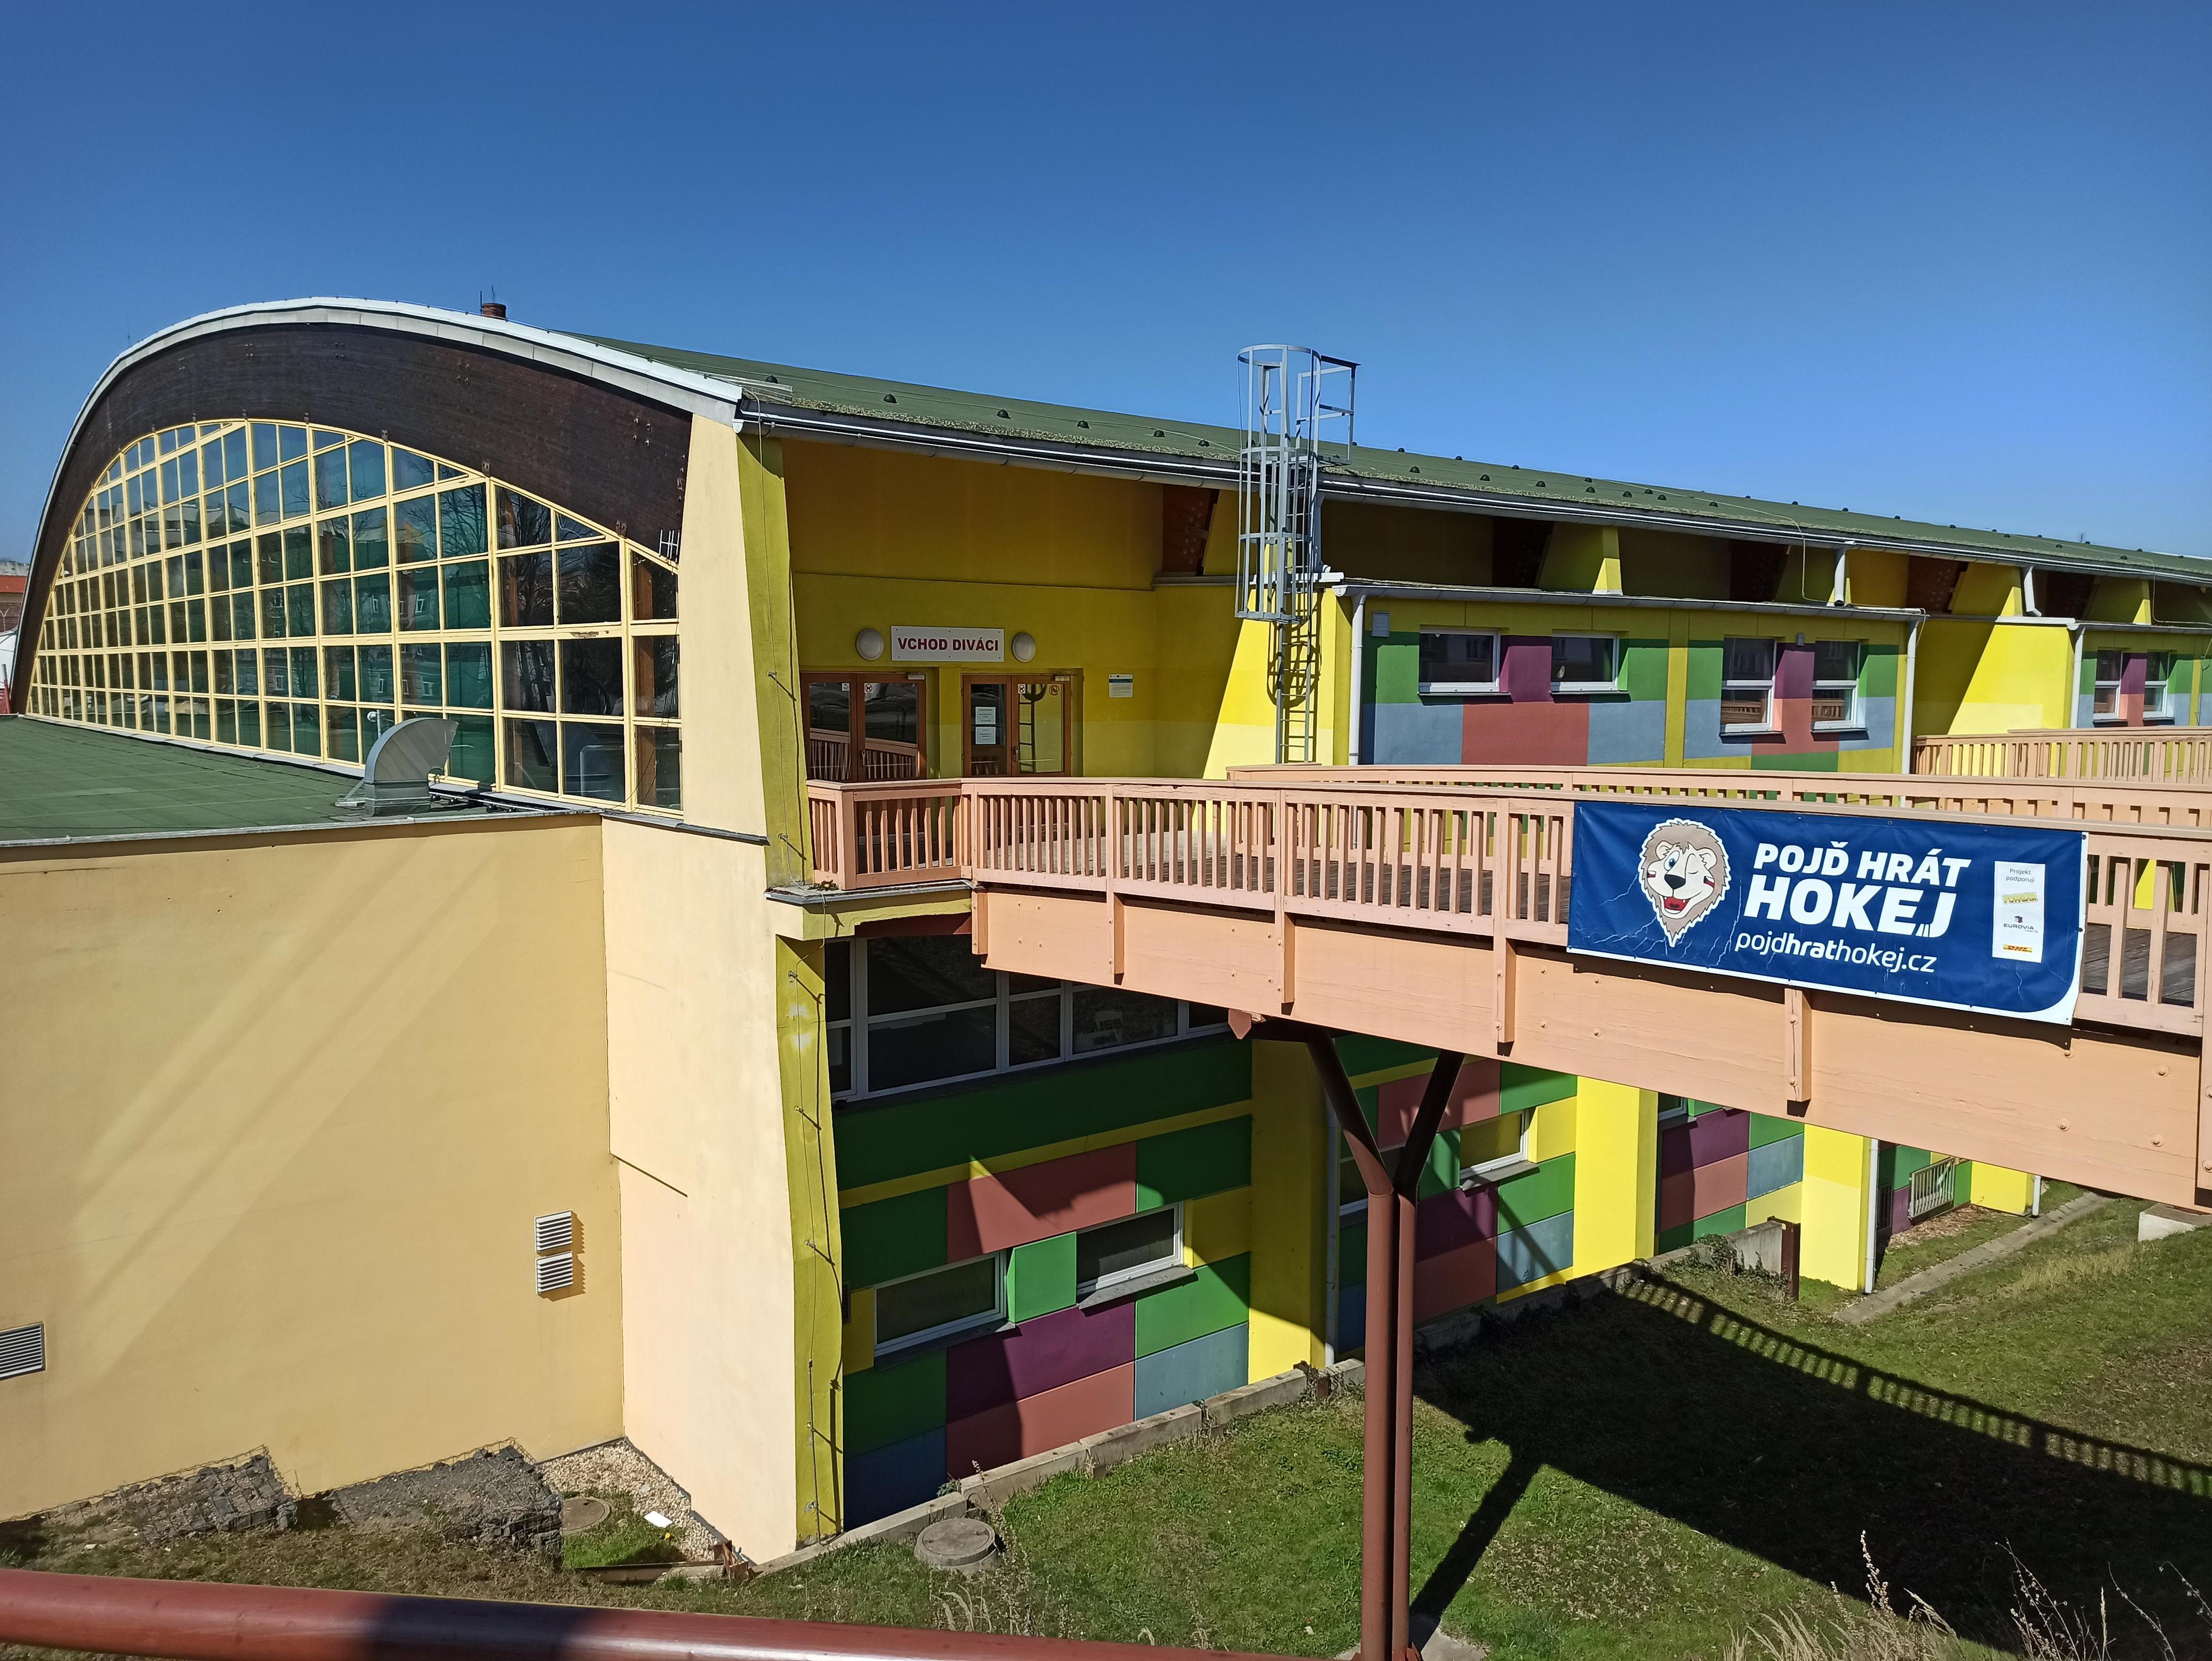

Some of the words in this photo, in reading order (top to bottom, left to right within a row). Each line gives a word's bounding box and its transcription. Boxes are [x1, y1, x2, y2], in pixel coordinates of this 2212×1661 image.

[898, 638, 947, 651] VCHOD
[952, 637, 998, 651] DIVÁCI
[1753, 840, 1849, 876] POJĎ
[1856, 848, 1972, 888] HRÁT
[1744, 874, 1957, 938] HOKEJ
[1734, 931, 1937, 973] pojdhrathokej.cz
